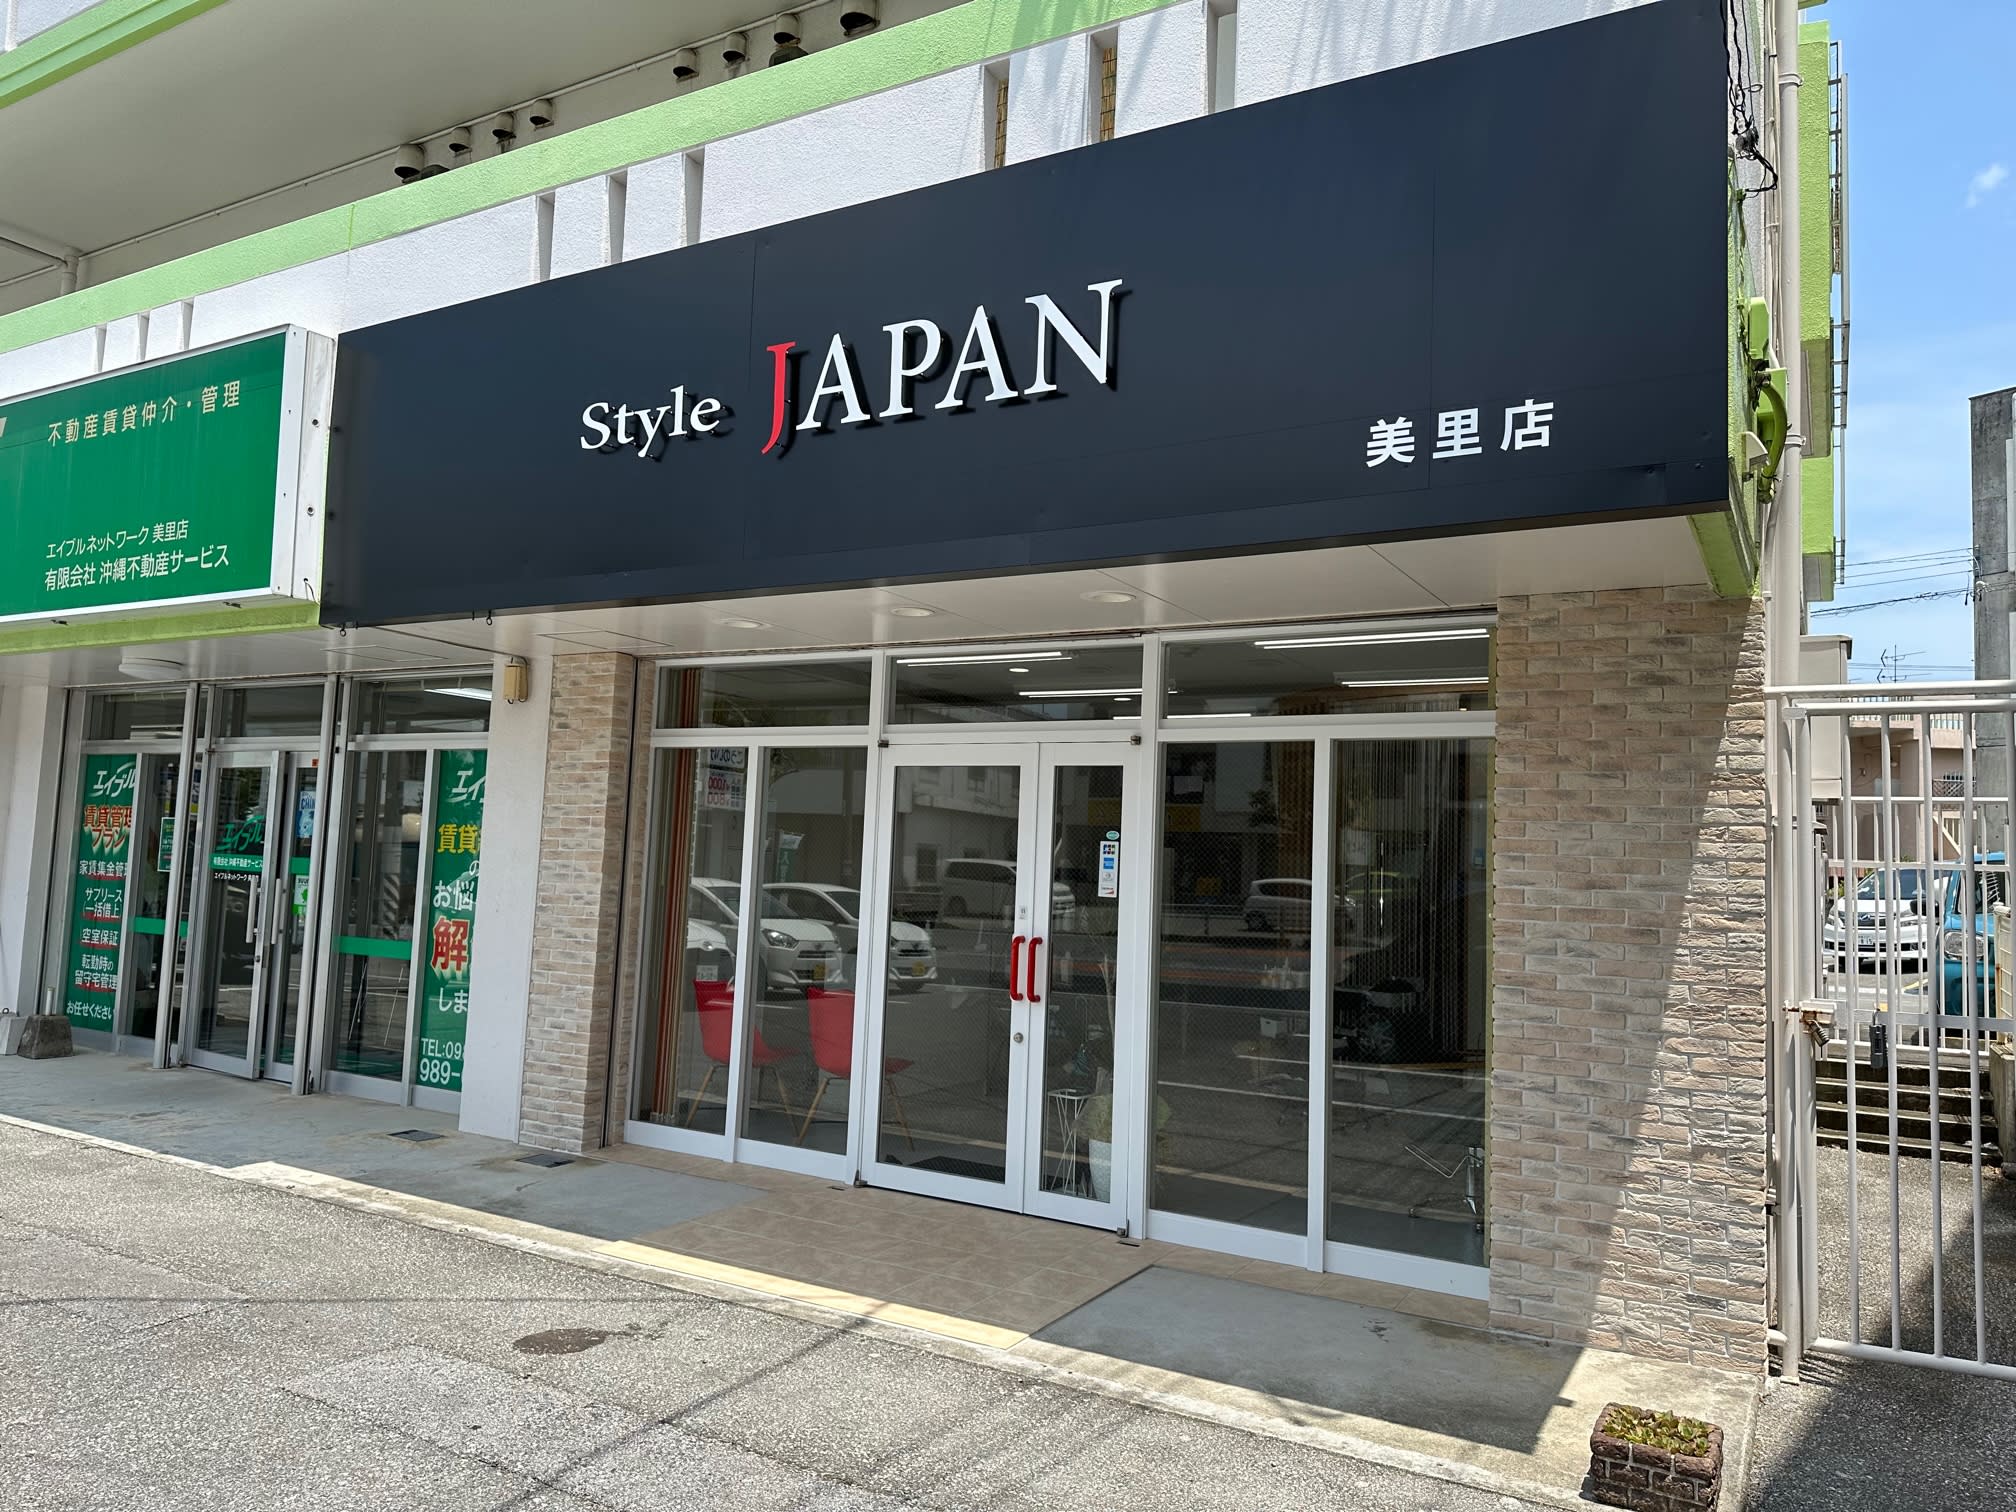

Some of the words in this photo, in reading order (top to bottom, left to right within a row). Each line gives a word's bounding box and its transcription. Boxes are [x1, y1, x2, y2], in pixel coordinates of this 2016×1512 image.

[580, 384, 721, 457] Style
[761, 279, 1123, 454] JAPAN
[47, 380, 241, 447] 不動産賃貸仲介・管理
[1366, 399, 1554, 468] 美里店
[46, 526, 149, 559] エイブルネットワーク
[152, 519, 189, 544] 美里店
[44, 562, 96, 591] 有限会社
[99, 544, 229, 584] 沖縄不動産サービス
[451, 770, 485, 803] エイ
[437, 823, 480, 854] 賃貸
[433, 880, 477, 911] お悩
[81, 928, 119, 946] 空室保証
[431, 916, 472, 972] 解
[82, 954, 114, 971] 転勤時の
[421, 1037, 464, 1060] TEL:09
